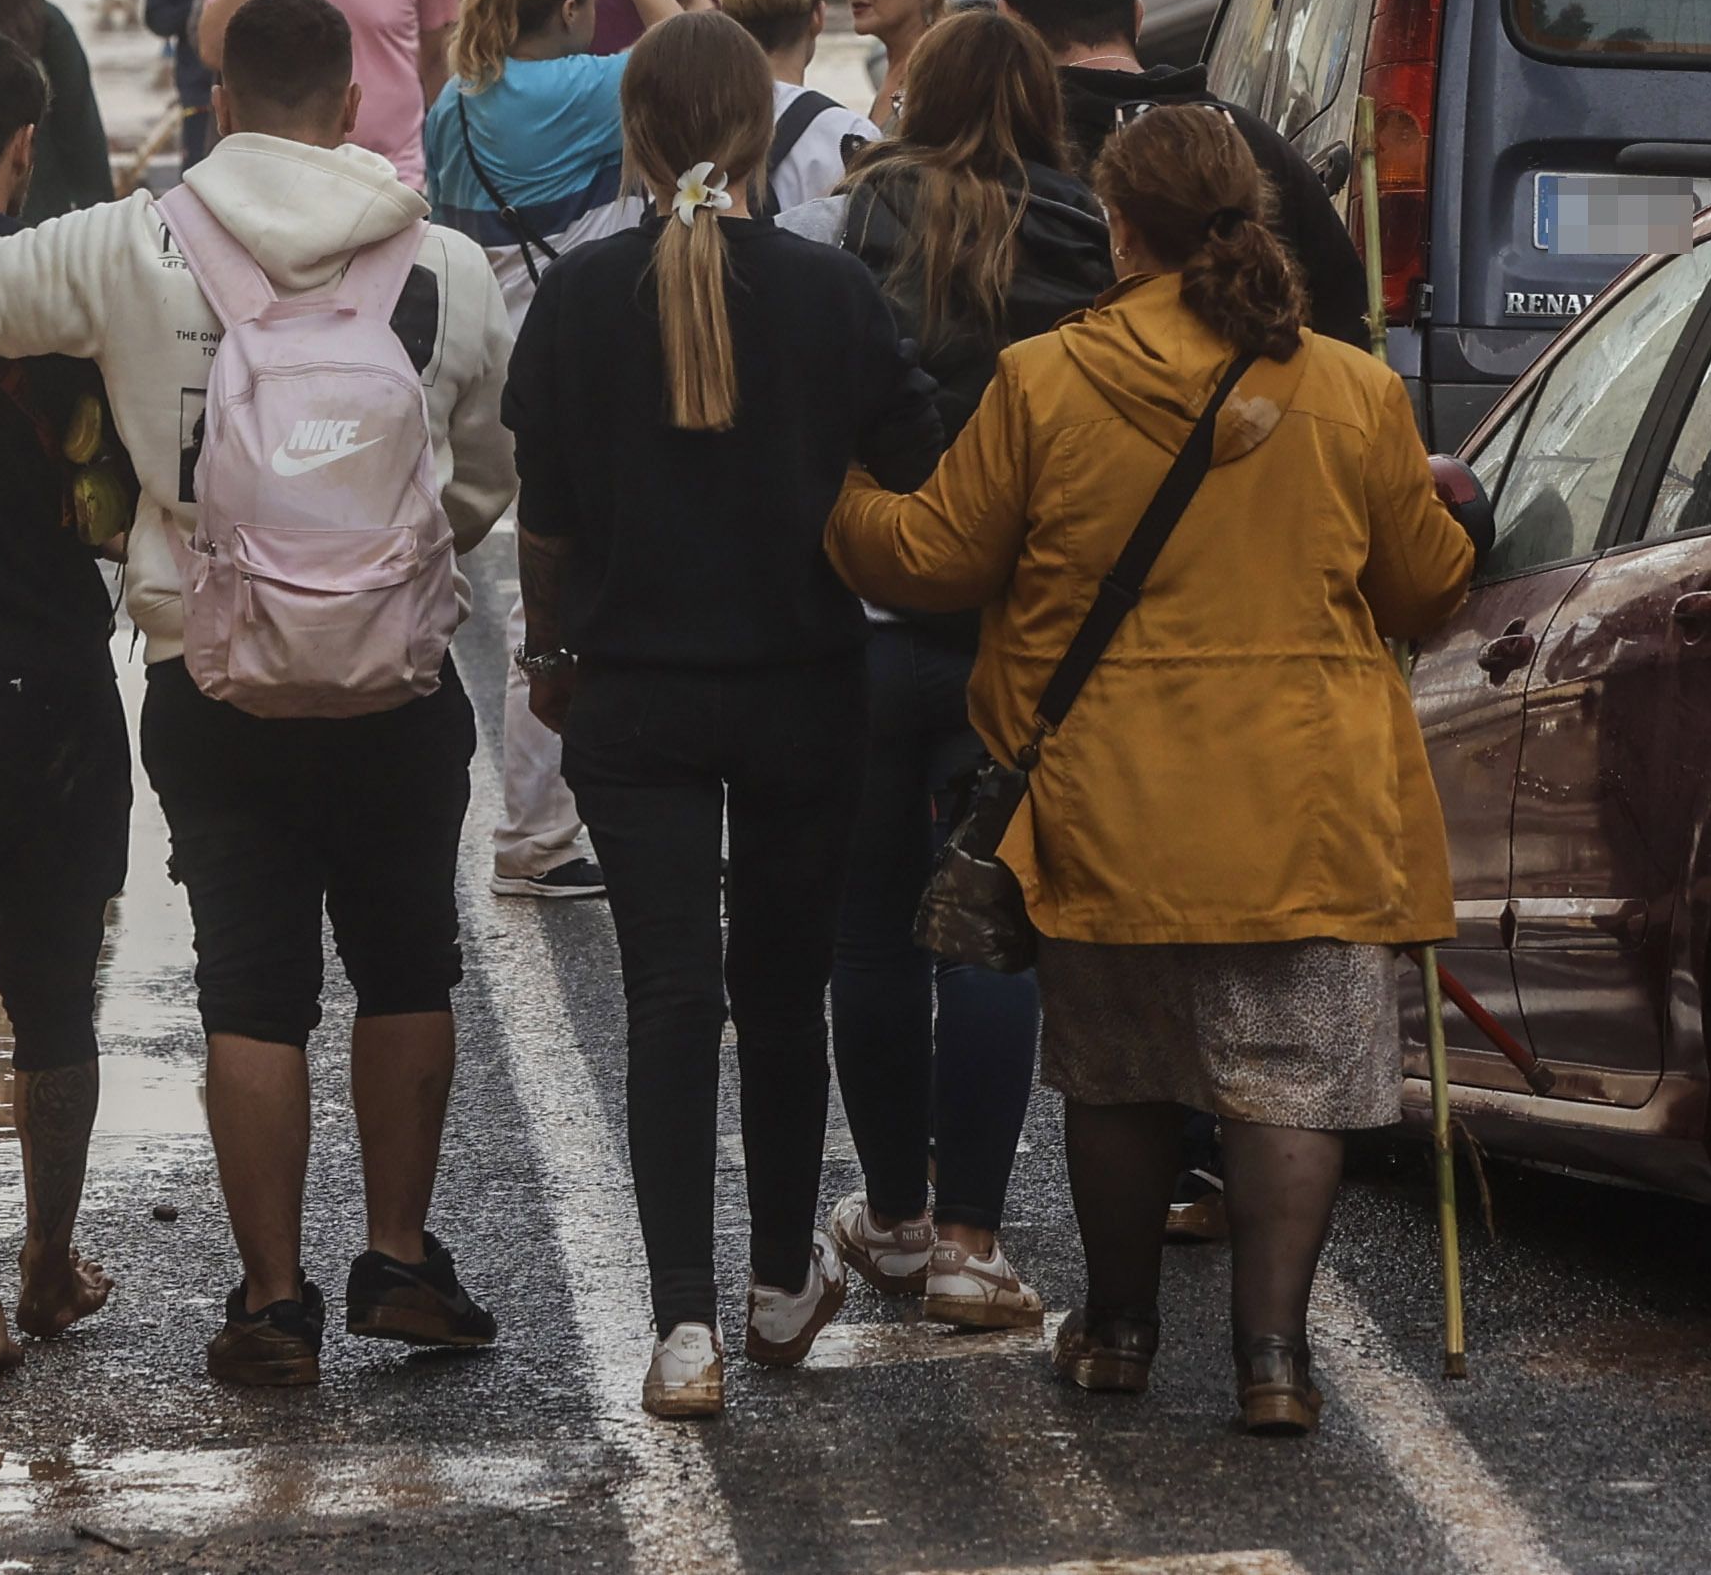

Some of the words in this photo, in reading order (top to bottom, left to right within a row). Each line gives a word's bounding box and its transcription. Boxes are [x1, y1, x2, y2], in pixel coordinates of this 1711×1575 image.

[1505, 292, 1598, 315] RENA
[176, 330, 197, 341] THE
[202, 347, 216, 357] TO
[287, 419, 361, 451] NIKE
[902, 1229, 926, 1241] NIKE
